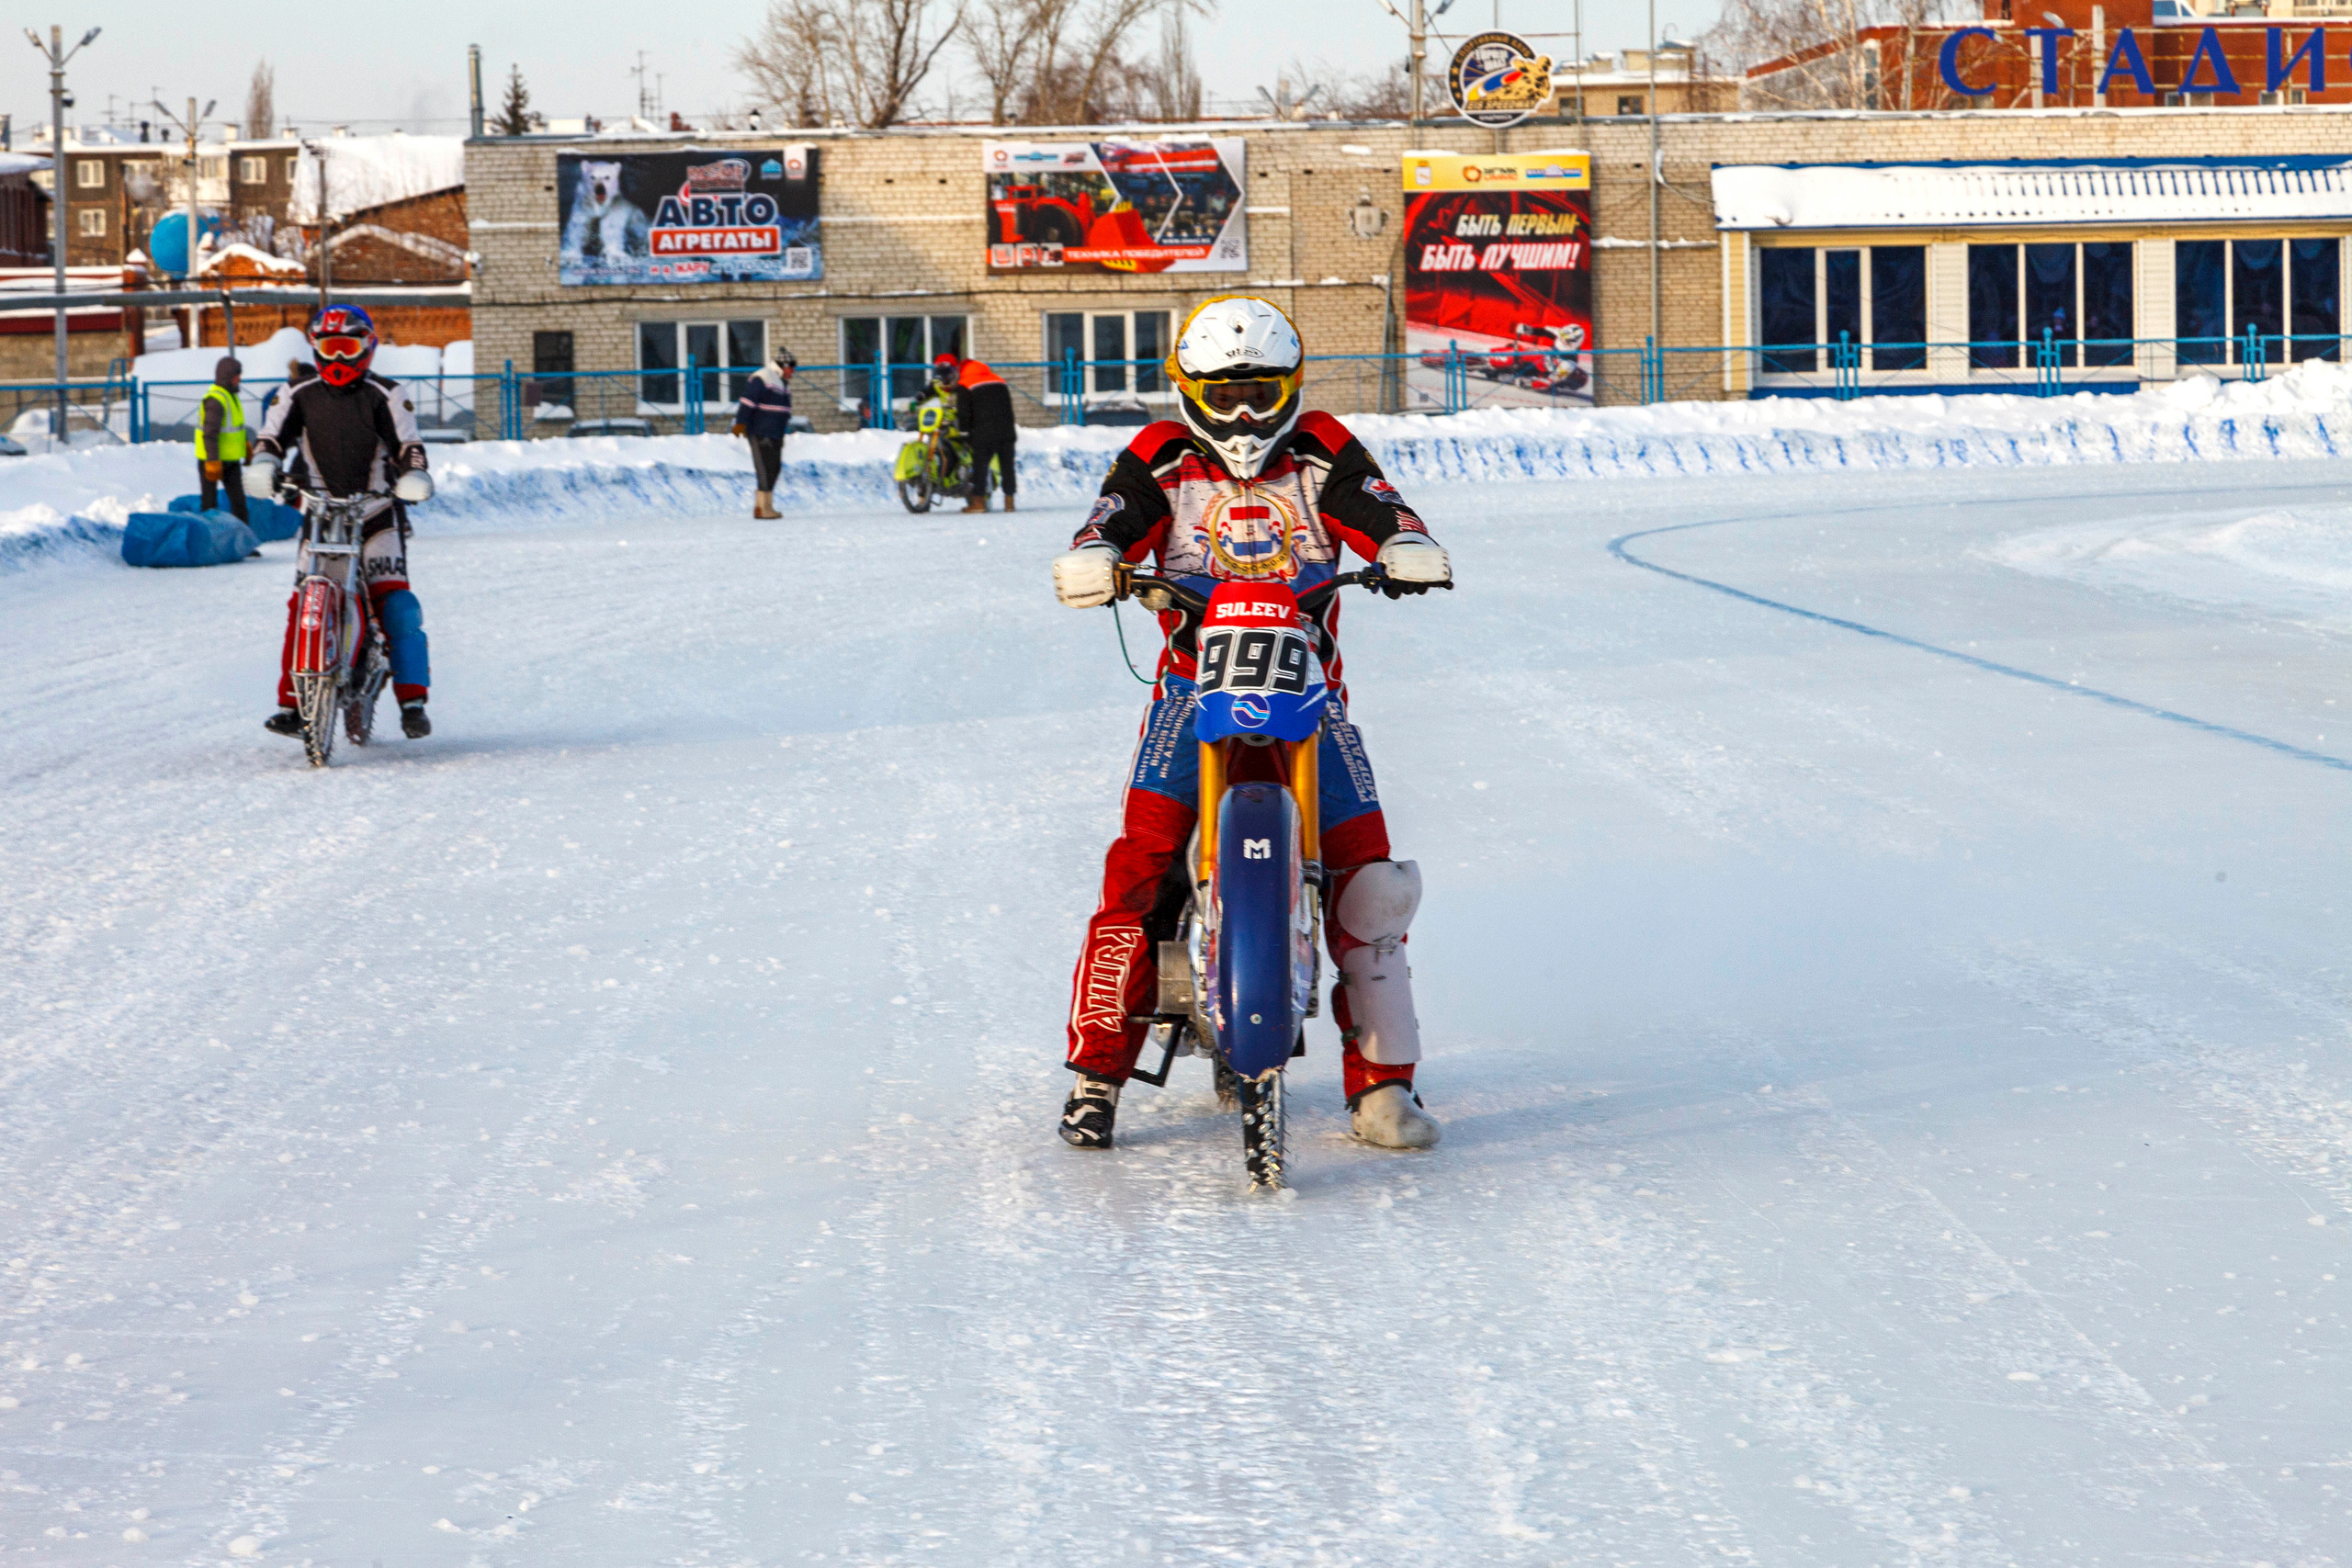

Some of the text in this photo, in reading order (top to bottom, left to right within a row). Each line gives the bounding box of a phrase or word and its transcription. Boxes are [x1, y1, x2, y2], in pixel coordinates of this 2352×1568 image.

[1939, 26, 2352, 96] СТАДИ
[652, 193, 778, 229] АВТО
[1455, 214, 1502, 237] БЫТЬ
[658, 231, 772, 251] АГРЕГАТЫ
[1067, 250, 1119, 261] ТЕХНИКА
[1419, 243, 1581, 272] БЫТЬ ЛУЧШИМ!
[1215, 602, 1291, 619] SULEEV
[1199, 628, 1309, 696] 999
[1149, 695, 1185, 767] ВИДОВ СПОРТА
[1136, 747, 1152, 784] ЦЕНТР
[1329, 721, 1371, 803] РЕСПУБЛИКА
